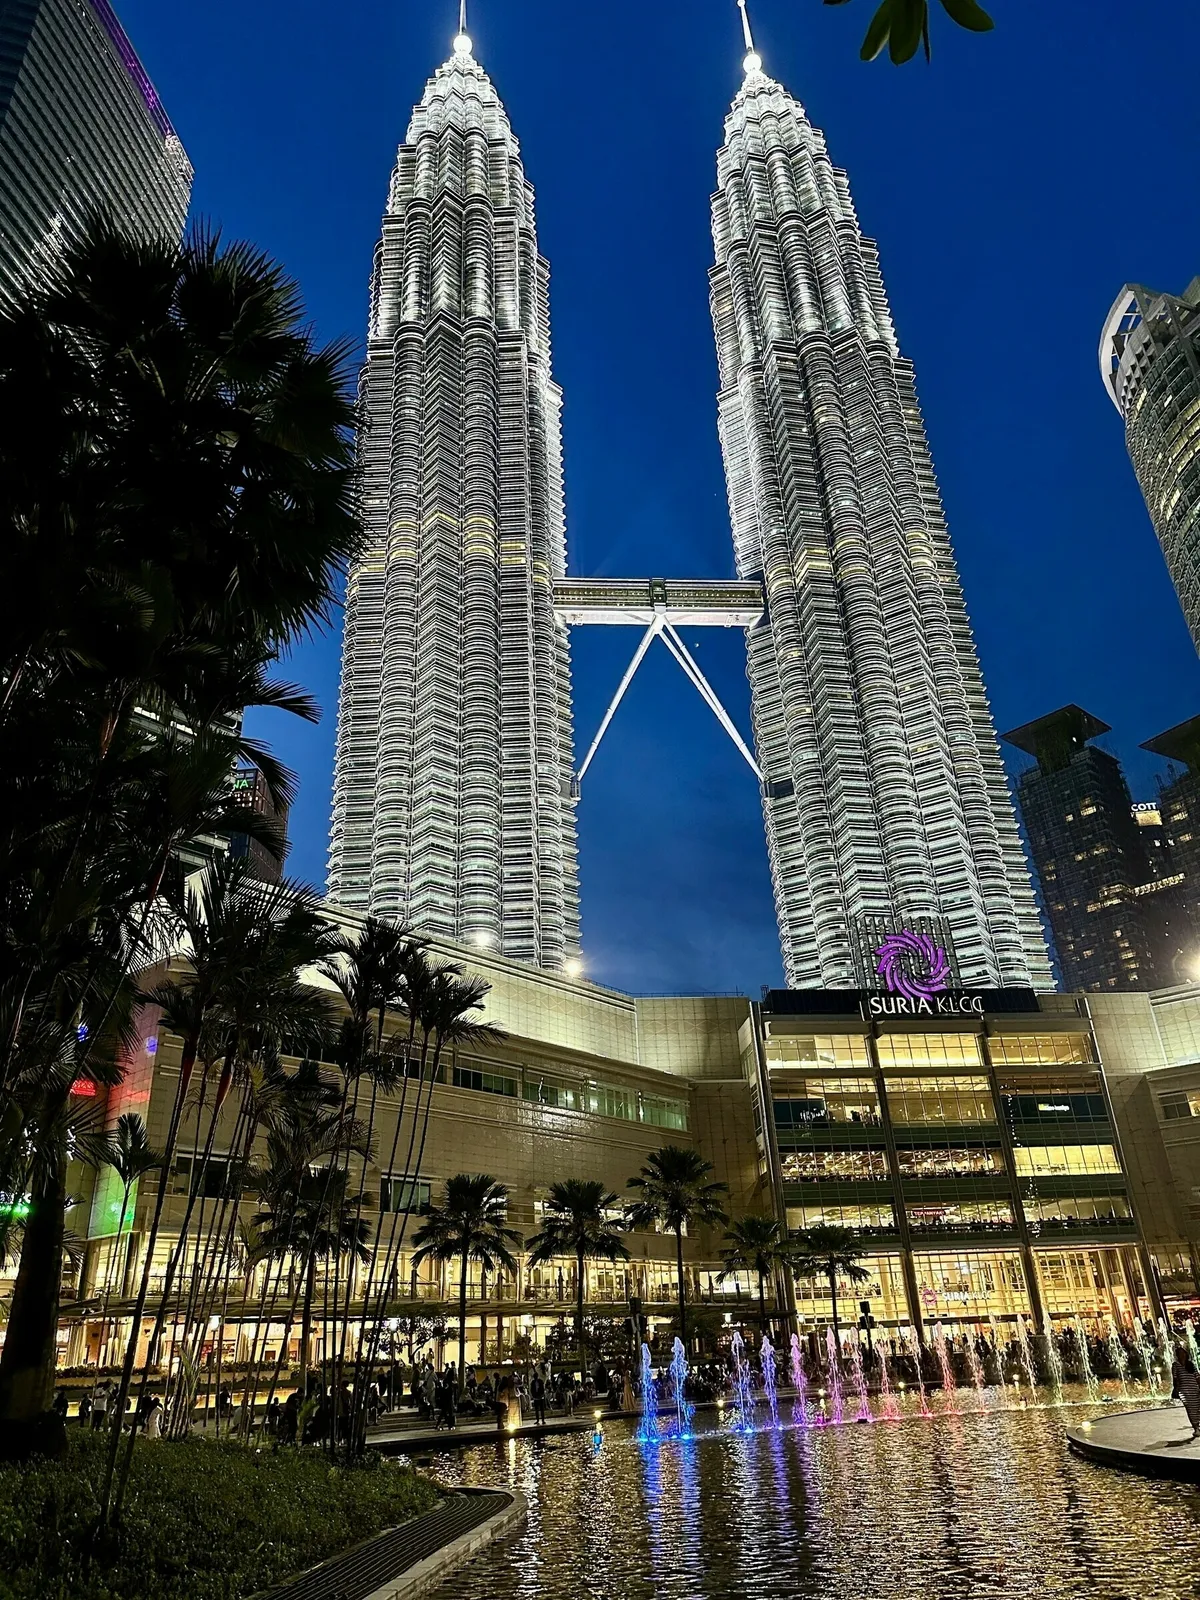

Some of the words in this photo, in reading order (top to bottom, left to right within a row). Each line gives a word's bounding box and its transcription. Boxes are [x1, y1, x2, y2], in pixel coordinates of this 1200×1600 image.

[870, 996, 933, 1015] SURIA
[936, 996, 985, 1013] KLCC
[942, 1291, 970, 1301] SURIA
